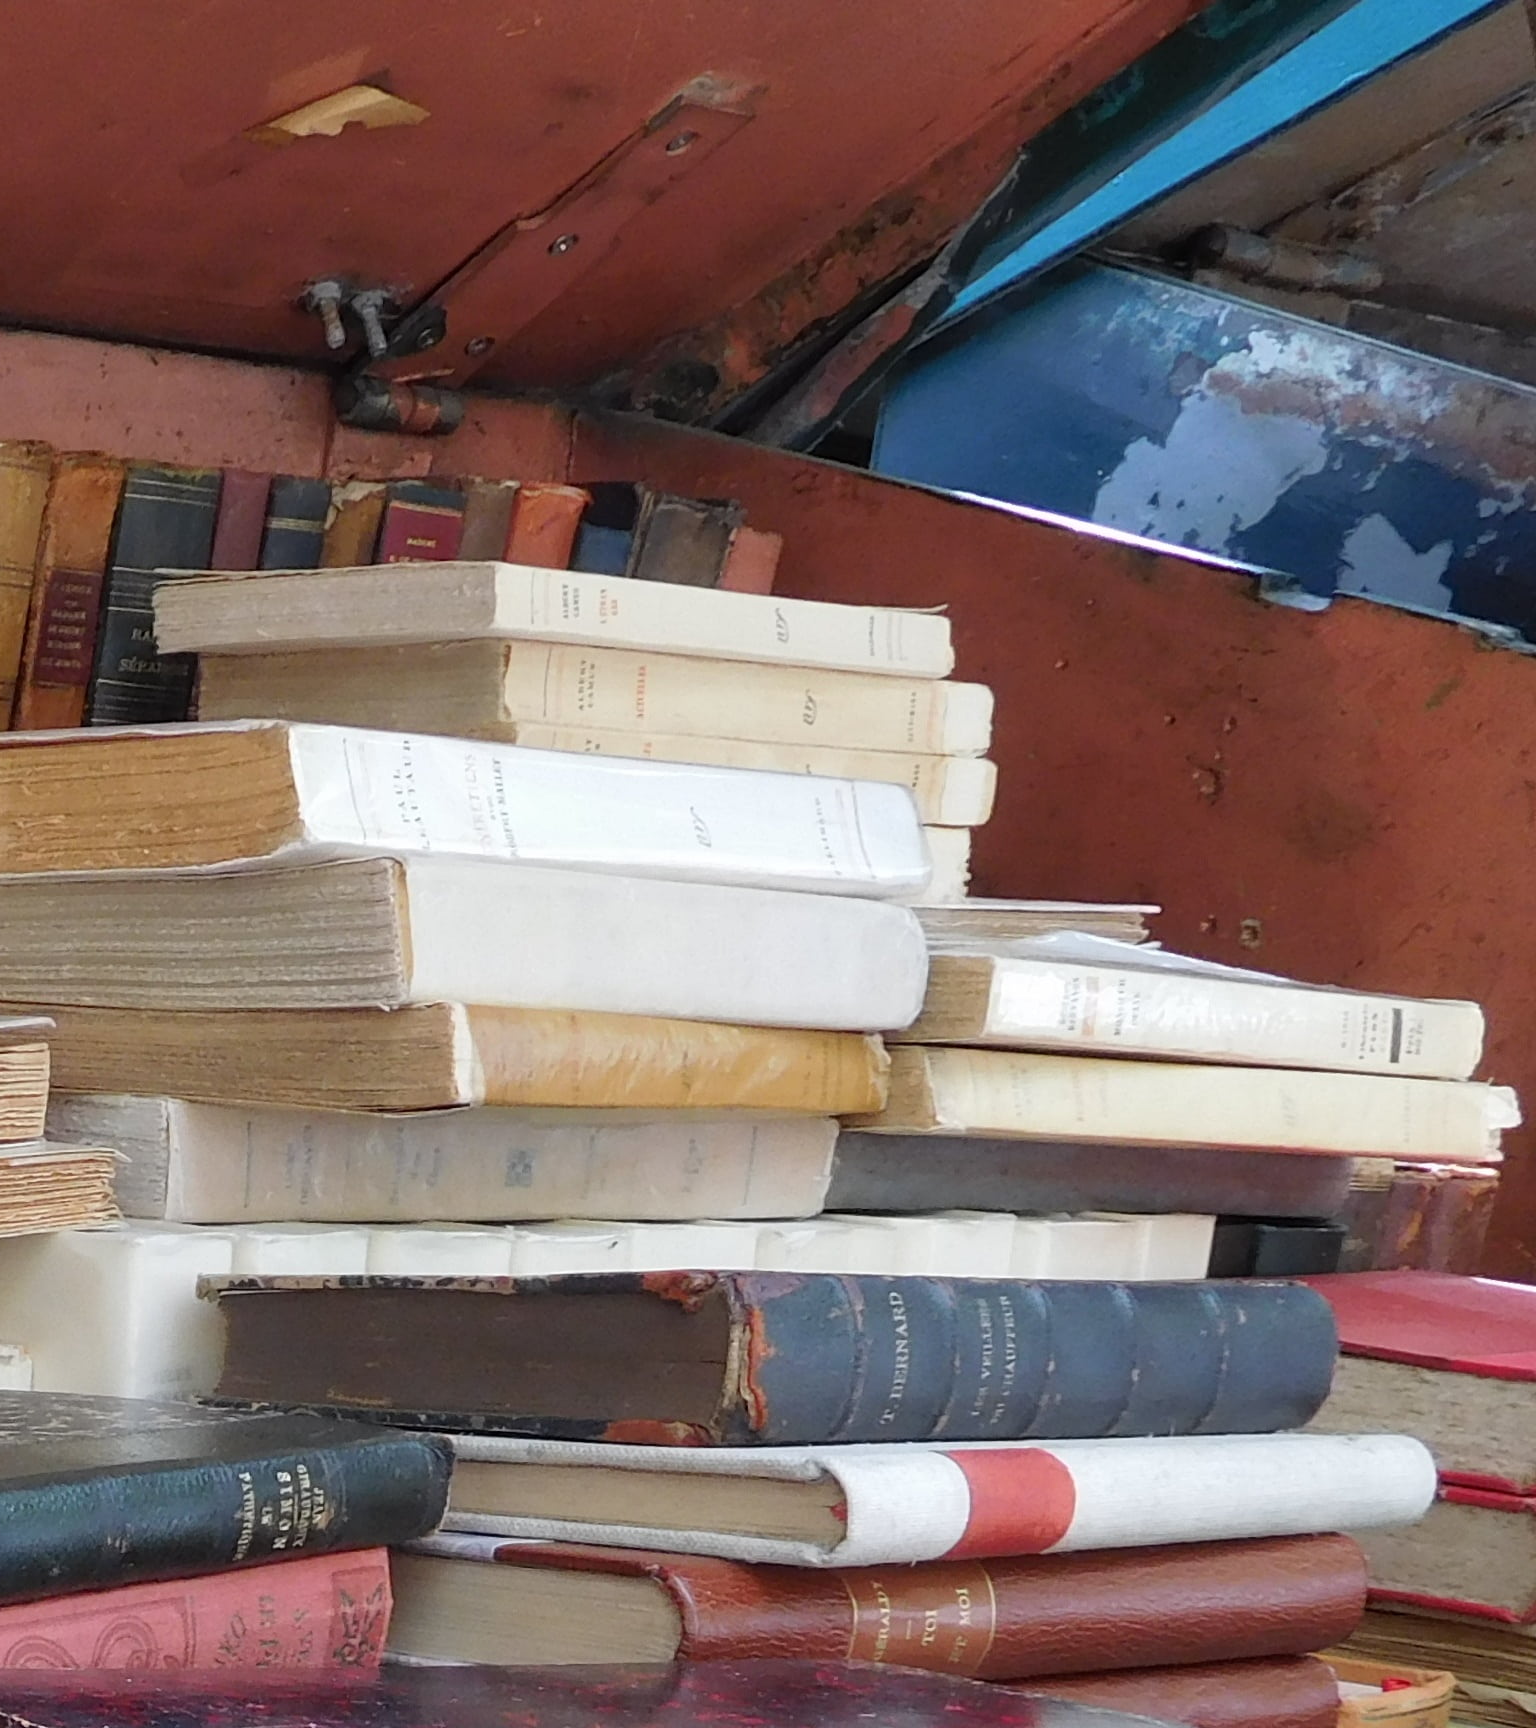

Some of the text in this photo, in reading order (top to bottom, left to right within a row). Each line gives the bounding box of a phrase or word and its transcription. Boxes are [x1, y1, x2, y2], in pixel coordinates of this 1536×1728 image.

[888, 1291, 911, 1400] BERNARD
[271, 1471, 294, 1550] SIMON
[311, 1487, 325, 1525] JEAN
[954, 1587, 972, 1627] MOI
[920, 1610, 938, 1647] TOI
